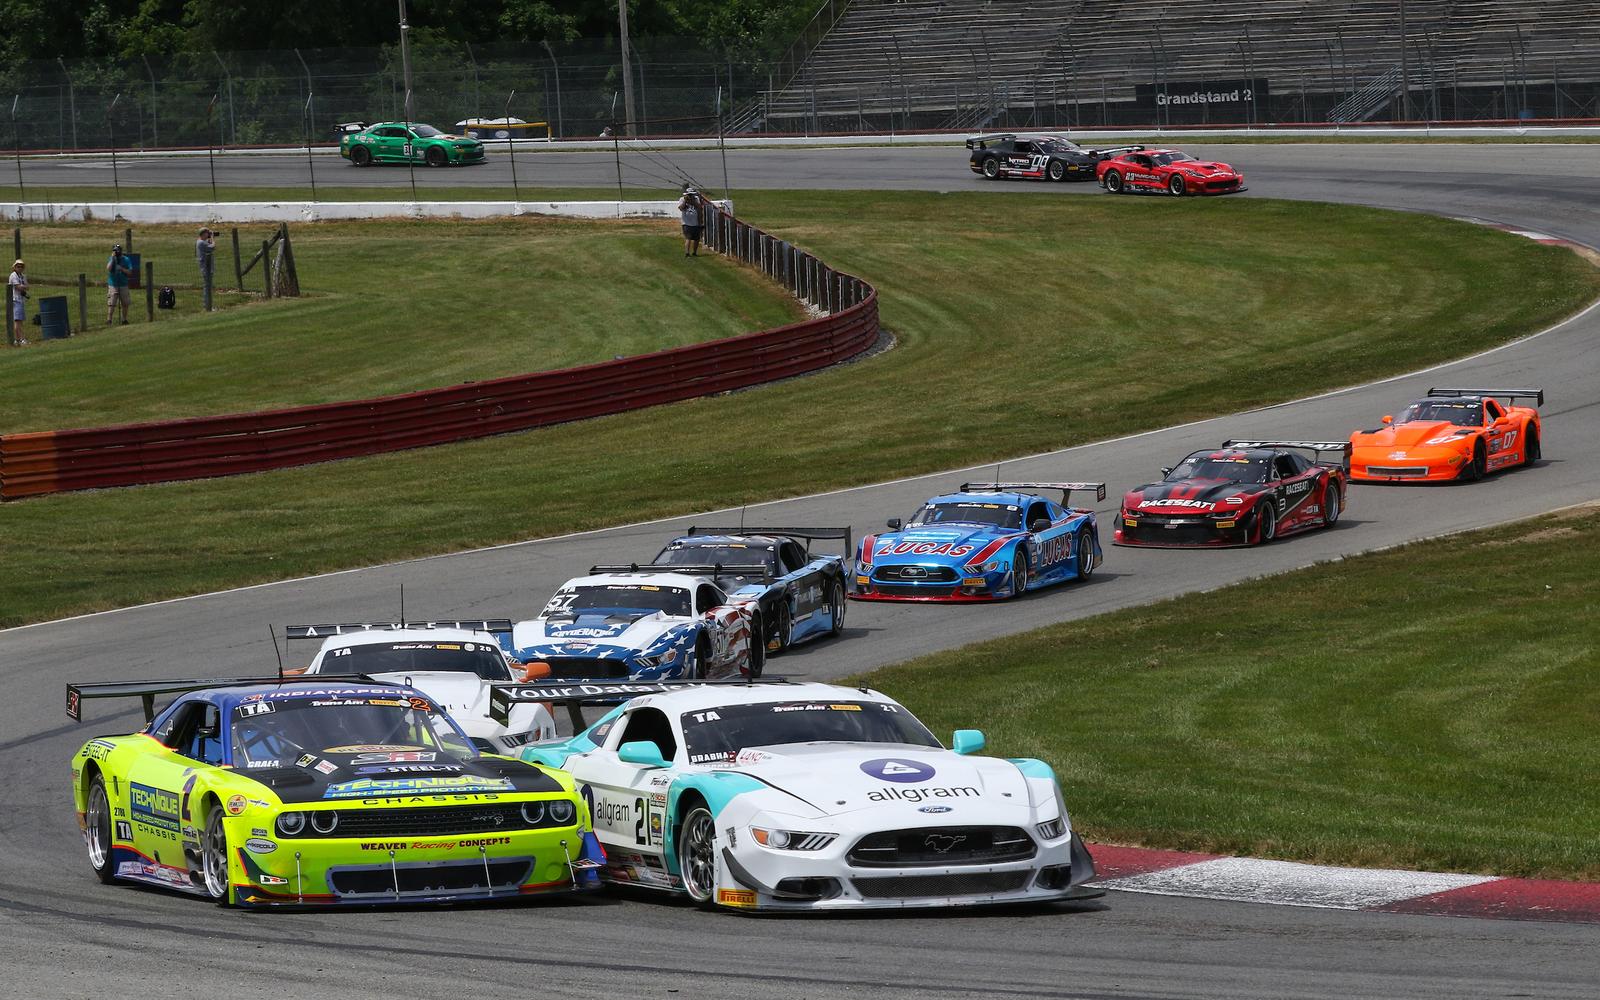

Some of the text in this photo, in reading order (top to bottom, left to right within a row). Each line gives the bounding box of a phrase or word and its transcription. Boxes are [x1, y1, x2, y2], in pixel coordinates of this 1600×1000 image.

[1157, 89, 1252, 105] Grandstand 2
[1032, 155, 1050, 168] 00
[1425, 435, 1466, 444] 07
[1503, 430, 1518, 449] 07
[874, 541, 975, 557] LUCAS
[1041, 532, 1073, 567] LUCAS
[549, 594, 580, 607] 57
[333, 648, 352, 657] TA
[270, 689, 415, 698] INDIANAPOLIS
[500, 683, 574, 698] Your
[579, 680, 648, 695] Data
[243, 703, 271, 716] TA
[409, 697, 431, 712] 2
[880, 704, 898, 713] 21
[692, 711, 721, 723] TA
[387, 766, 465, 774] STEEL-IT
[333, 775, 506, 792] TECHNIQUE
[331, 789, 418, 798] HIGH-SPEED
[362, 794, 499, 806] CHASSIS
[866, 786, 980, 802] allgram
[131, 788, 178, 816] TECHNIQUE
[924, 805, 947, 813] Ford
[597, 797, 631, 826] allgram
[634, 797, 652, 846] 21
[118, 823, 133, 840] TA
[138, 824, 177, 841] CHASSIS
[361, 837, 511, 850] WEAVER Racing CONCEPTS
[721, 890, 754, 904] PIRELLI
